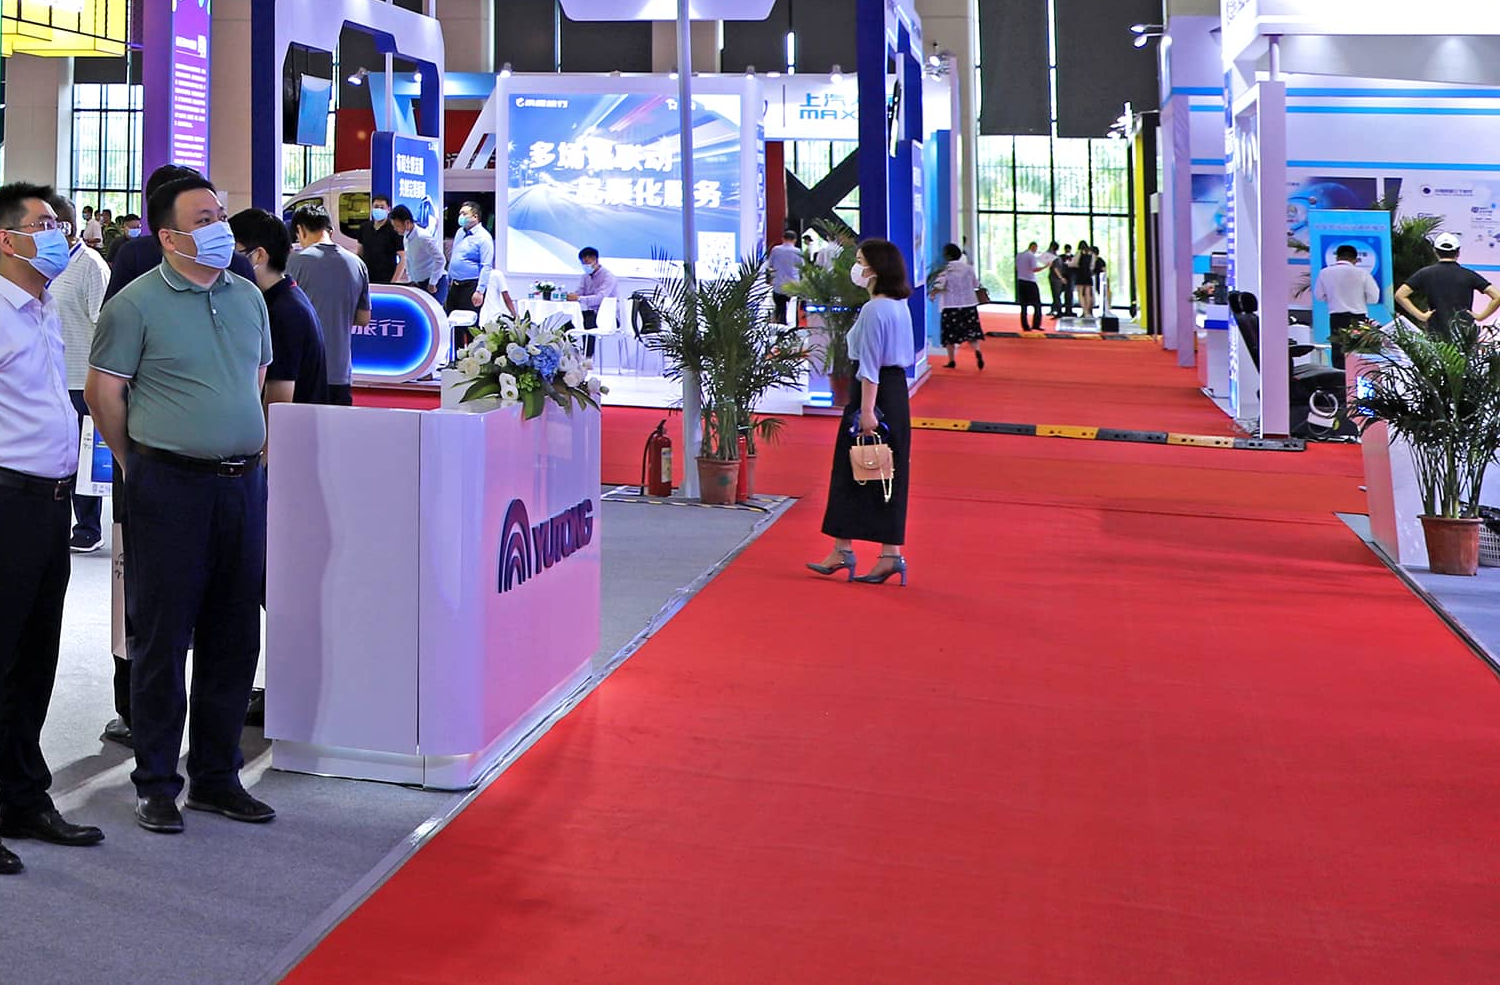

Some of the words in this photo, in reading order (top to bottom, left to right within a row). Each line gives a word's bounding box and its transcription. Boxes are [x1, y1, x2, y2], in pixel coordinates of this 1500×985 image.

[800, 93, 859, 107] 上汽
[800, 109, 859, 120] MAX
[531, 499, 593, 574] YUTONG
